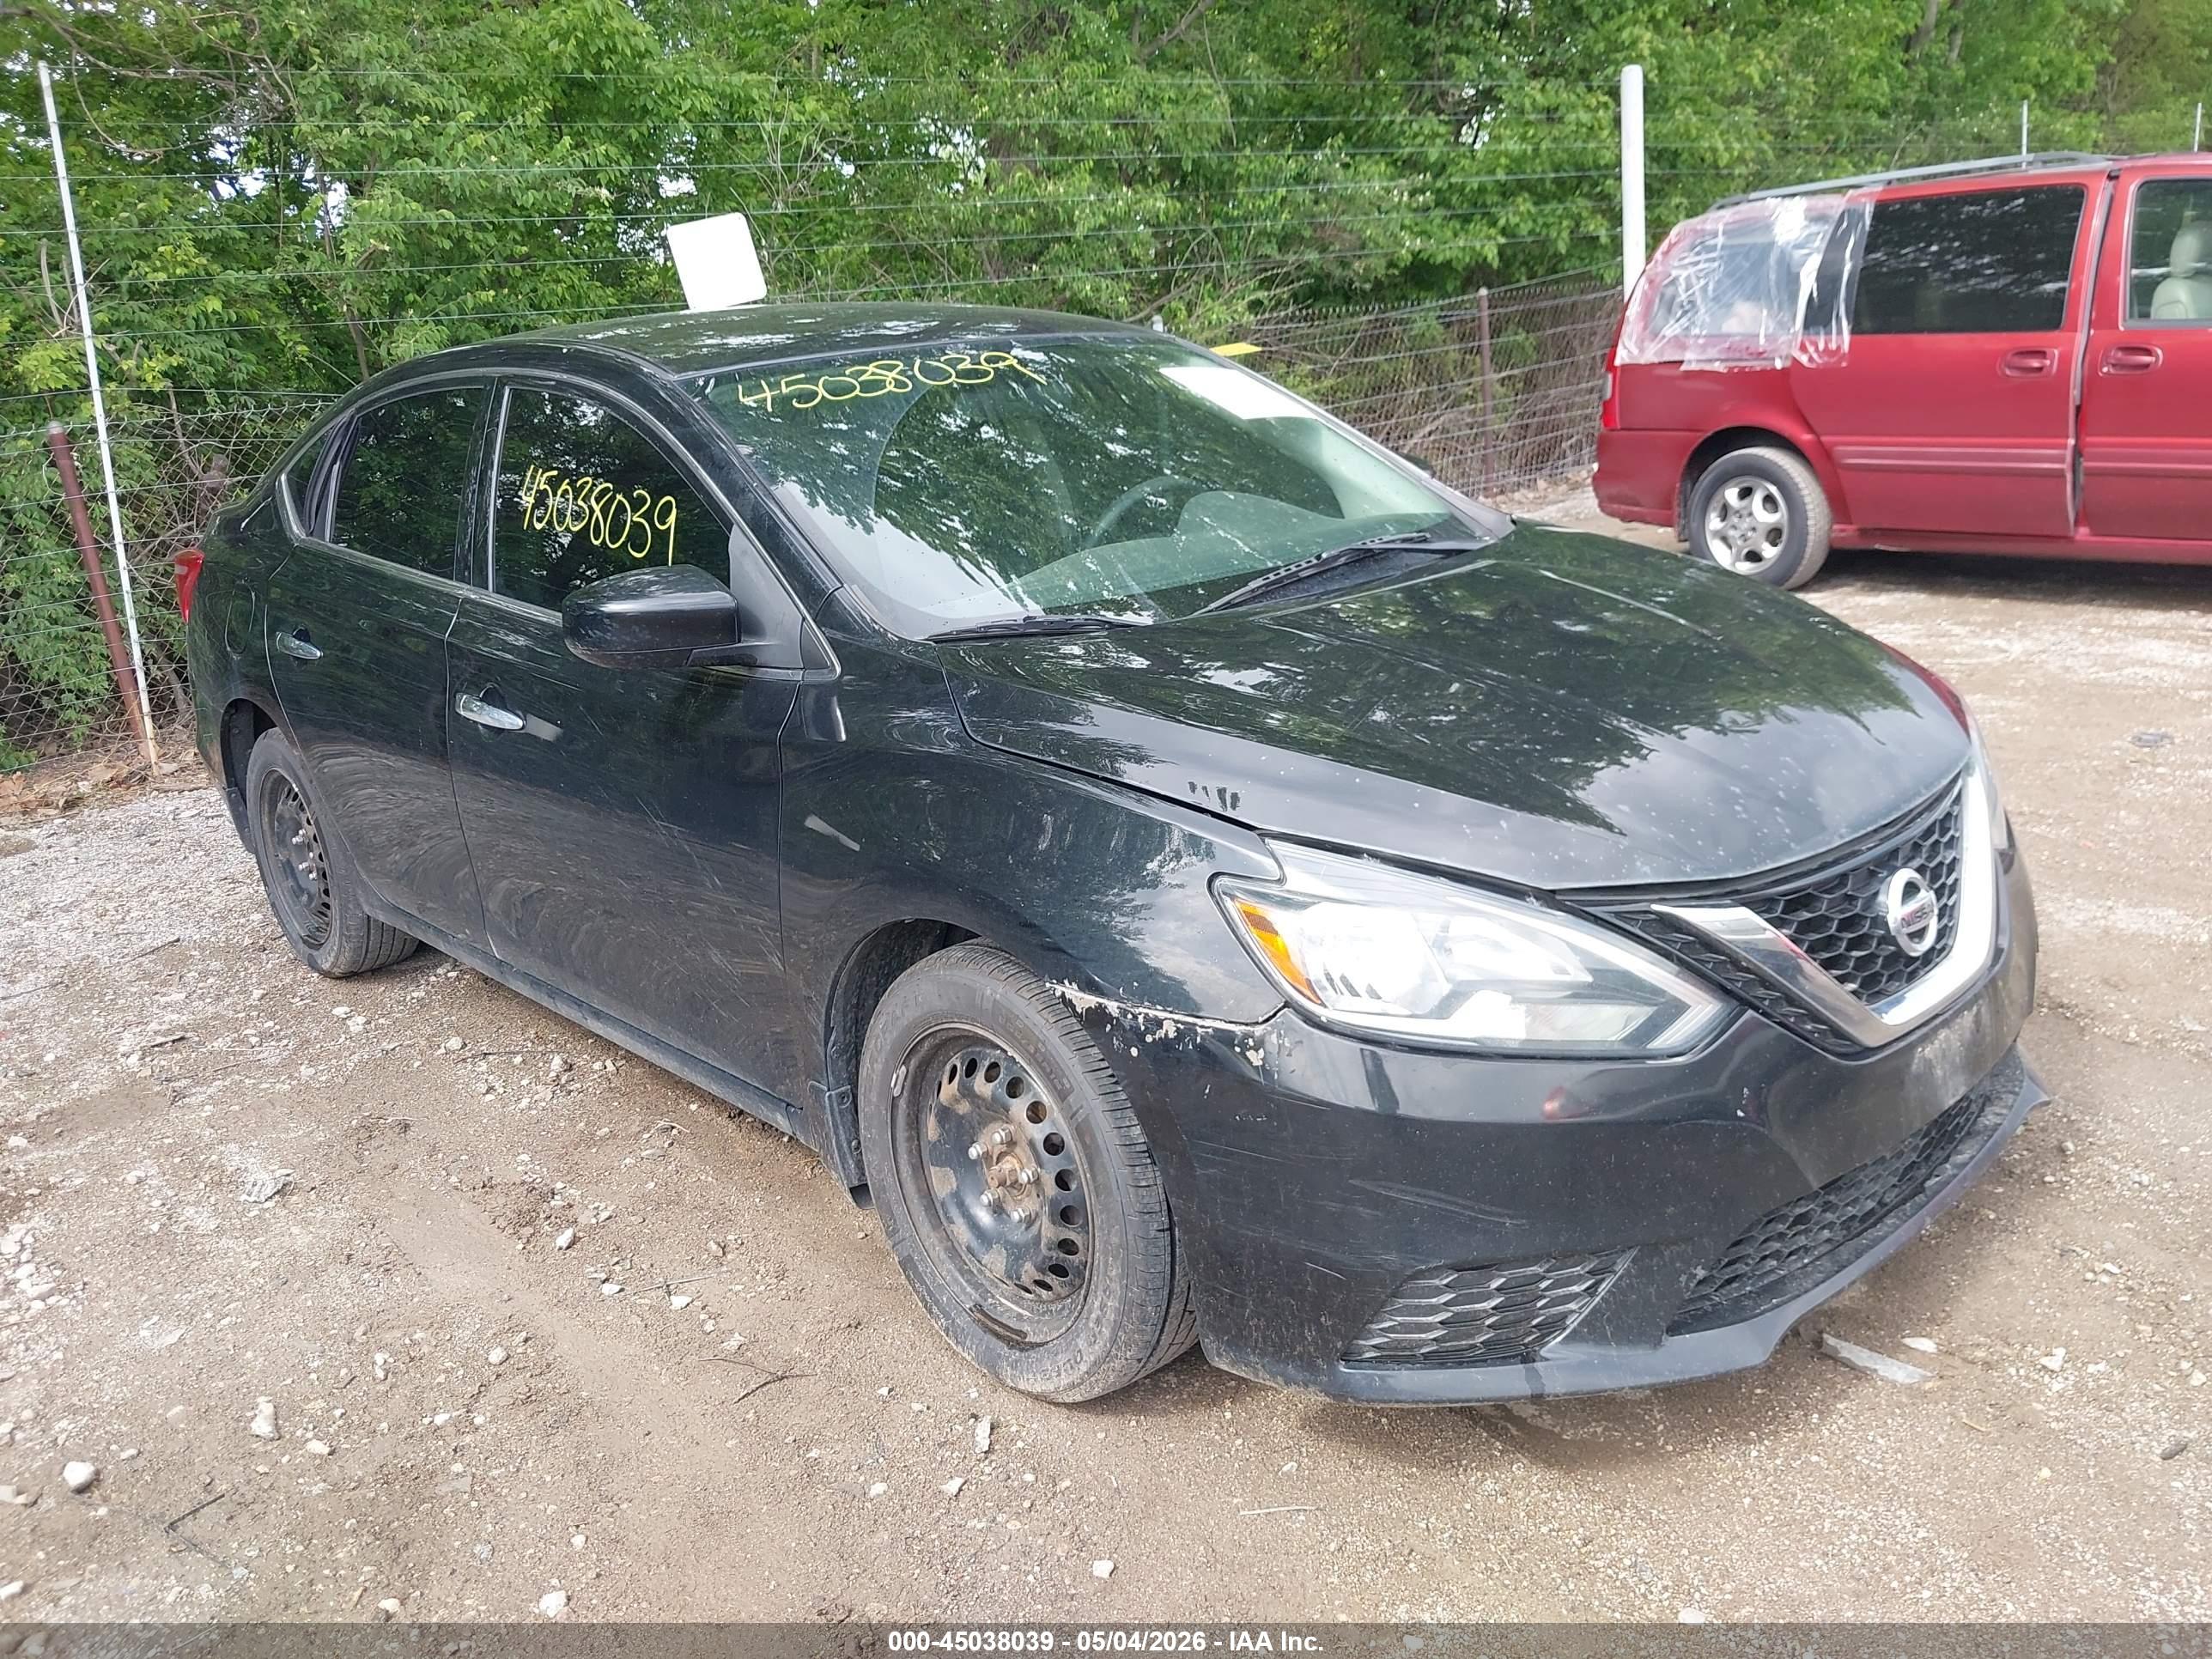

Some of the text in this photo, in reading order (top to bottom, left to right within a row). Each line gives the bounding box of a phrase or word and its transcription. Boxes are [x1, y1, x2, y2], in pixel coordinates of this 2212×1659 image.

[737, 351, 1048, 412] 45038039
[522, 465, 677, 567] 45038039
[1900, 902, 1935, 928] NISSA
